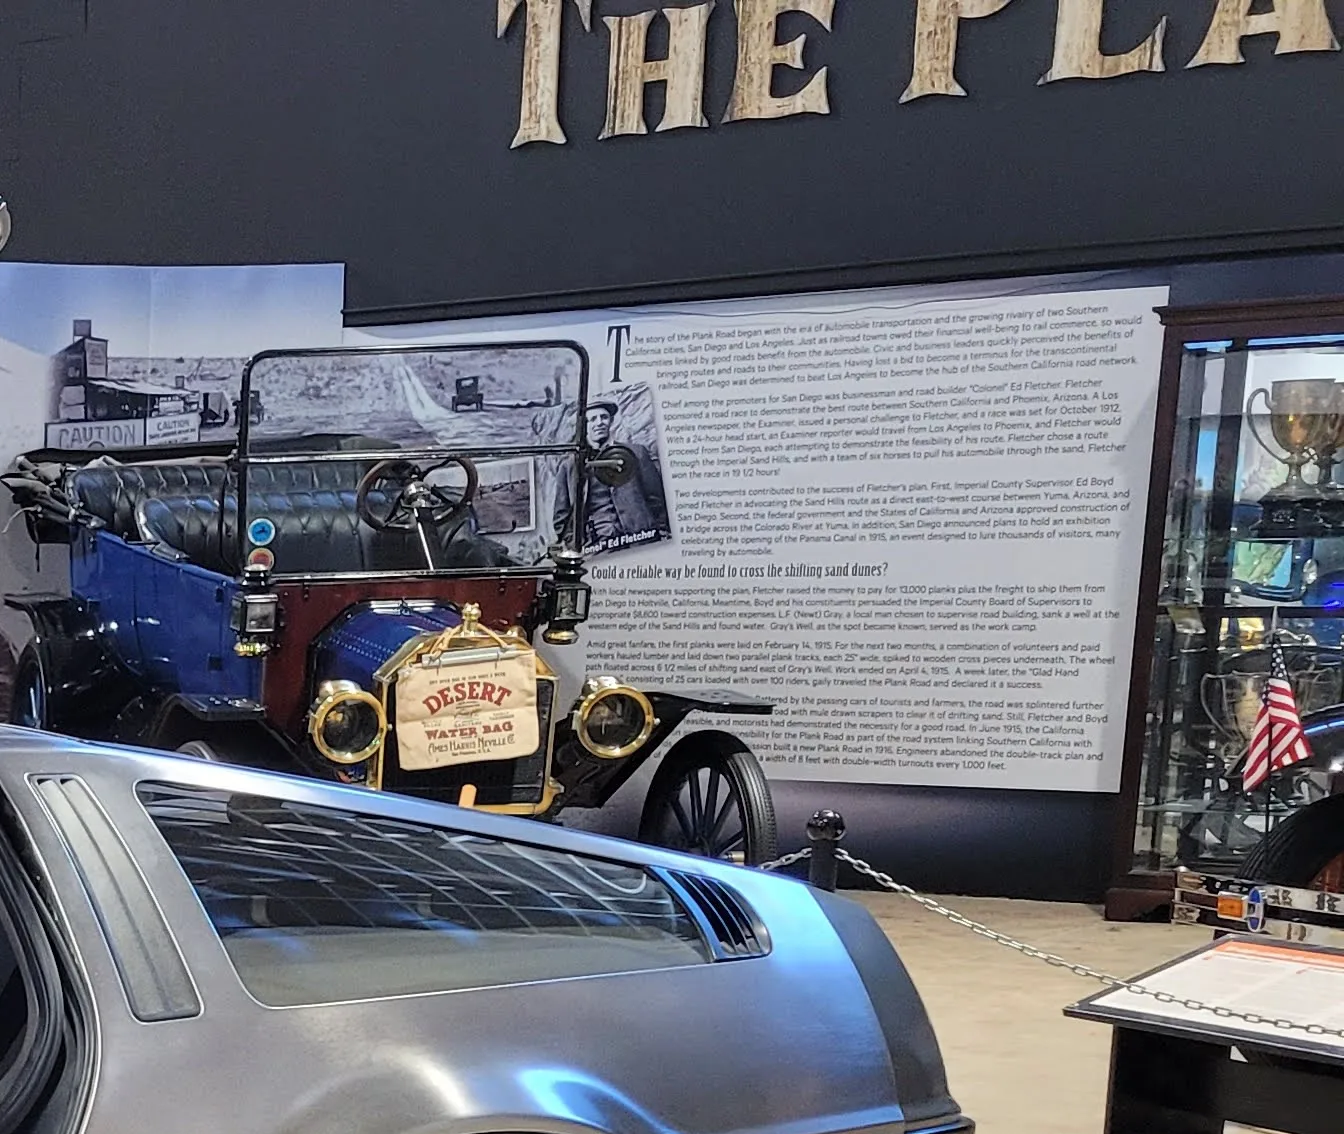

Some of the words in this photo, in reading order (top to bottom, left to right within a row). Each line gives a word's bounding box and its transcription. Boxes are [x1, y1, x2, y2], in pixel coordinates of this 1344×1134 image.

[496, 0, 832, 148] THE
[606, 324, 631, 383] T
[59, 423, 136, 448] CAUTION
[582, 540, 606, 554] lonel"
[607, 537, 619, 549] Ed
[620, 529, 656, 545] Fletcher
[590, 565, 616, 579] Could
[626, 565, 663, 578] reliable
[663, 568, 683, 580] way
[684, 564, 697, 577] be
[697, 564, 725, 577] found
[727, 564, 738, 577] to
[739, 567, 765, 577] cross
[766, 564, 782, 577] the
[784, 564, 822, 579] shifting
[824, 563, 848, 577] sand
[851, 563, 888, 576] dunes?
[422, 681, 512, 715] DESERT
[425, 727, 477, 740] WATER
[482, 721, 513, 734] BAG
